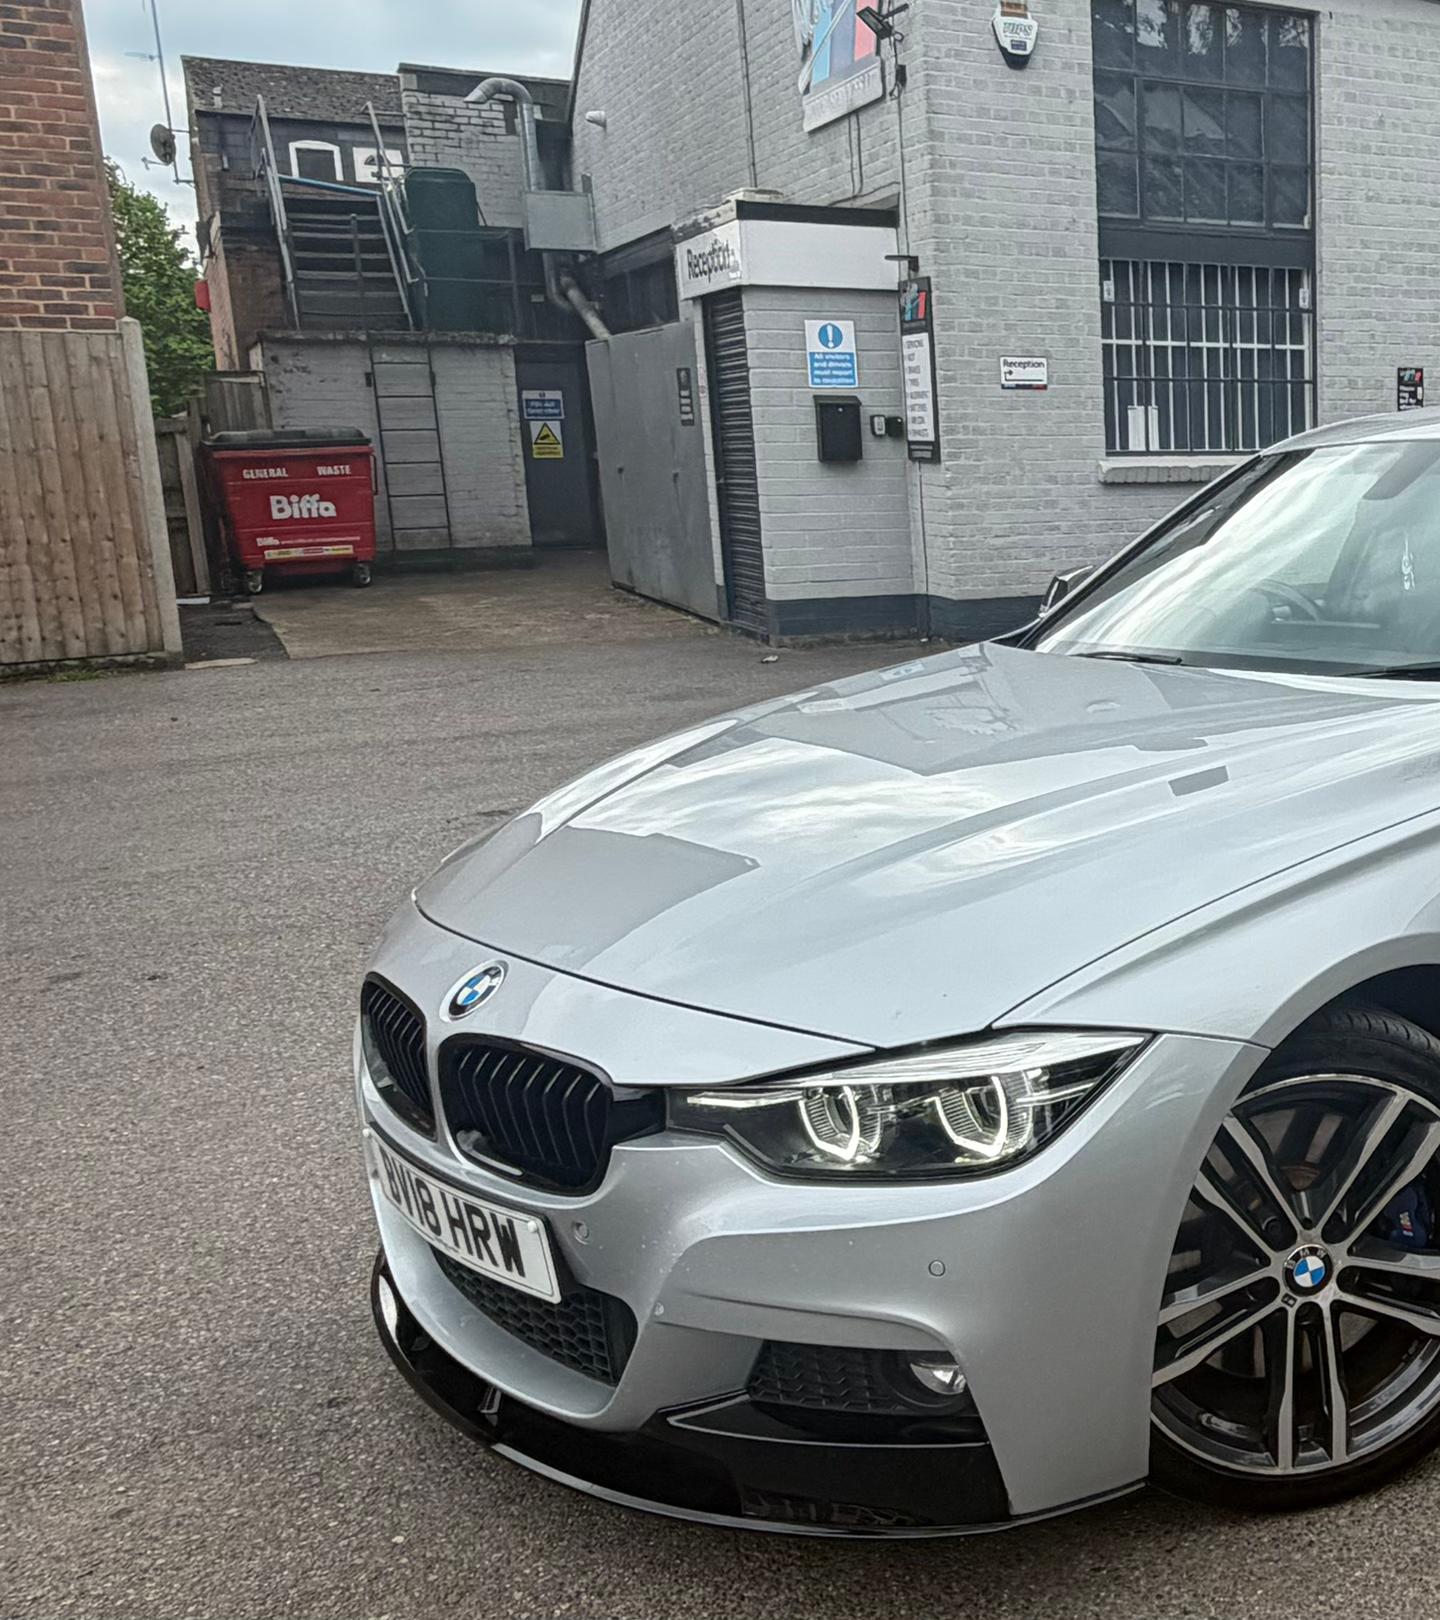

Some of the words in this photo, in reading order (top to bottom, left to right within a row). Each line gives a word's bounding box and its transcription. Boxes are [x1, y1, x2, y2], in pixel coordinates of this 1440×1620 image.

[686, 238, 731, 284] Reception
[1003, 359, 1045, 370] Reception
[242, 467, 289, 479] GENERAL
[316, 465, 352, 475] WASTE
[269, 493, 337, 520] Biffa
[439, 1189, 526, 1278] HRW
